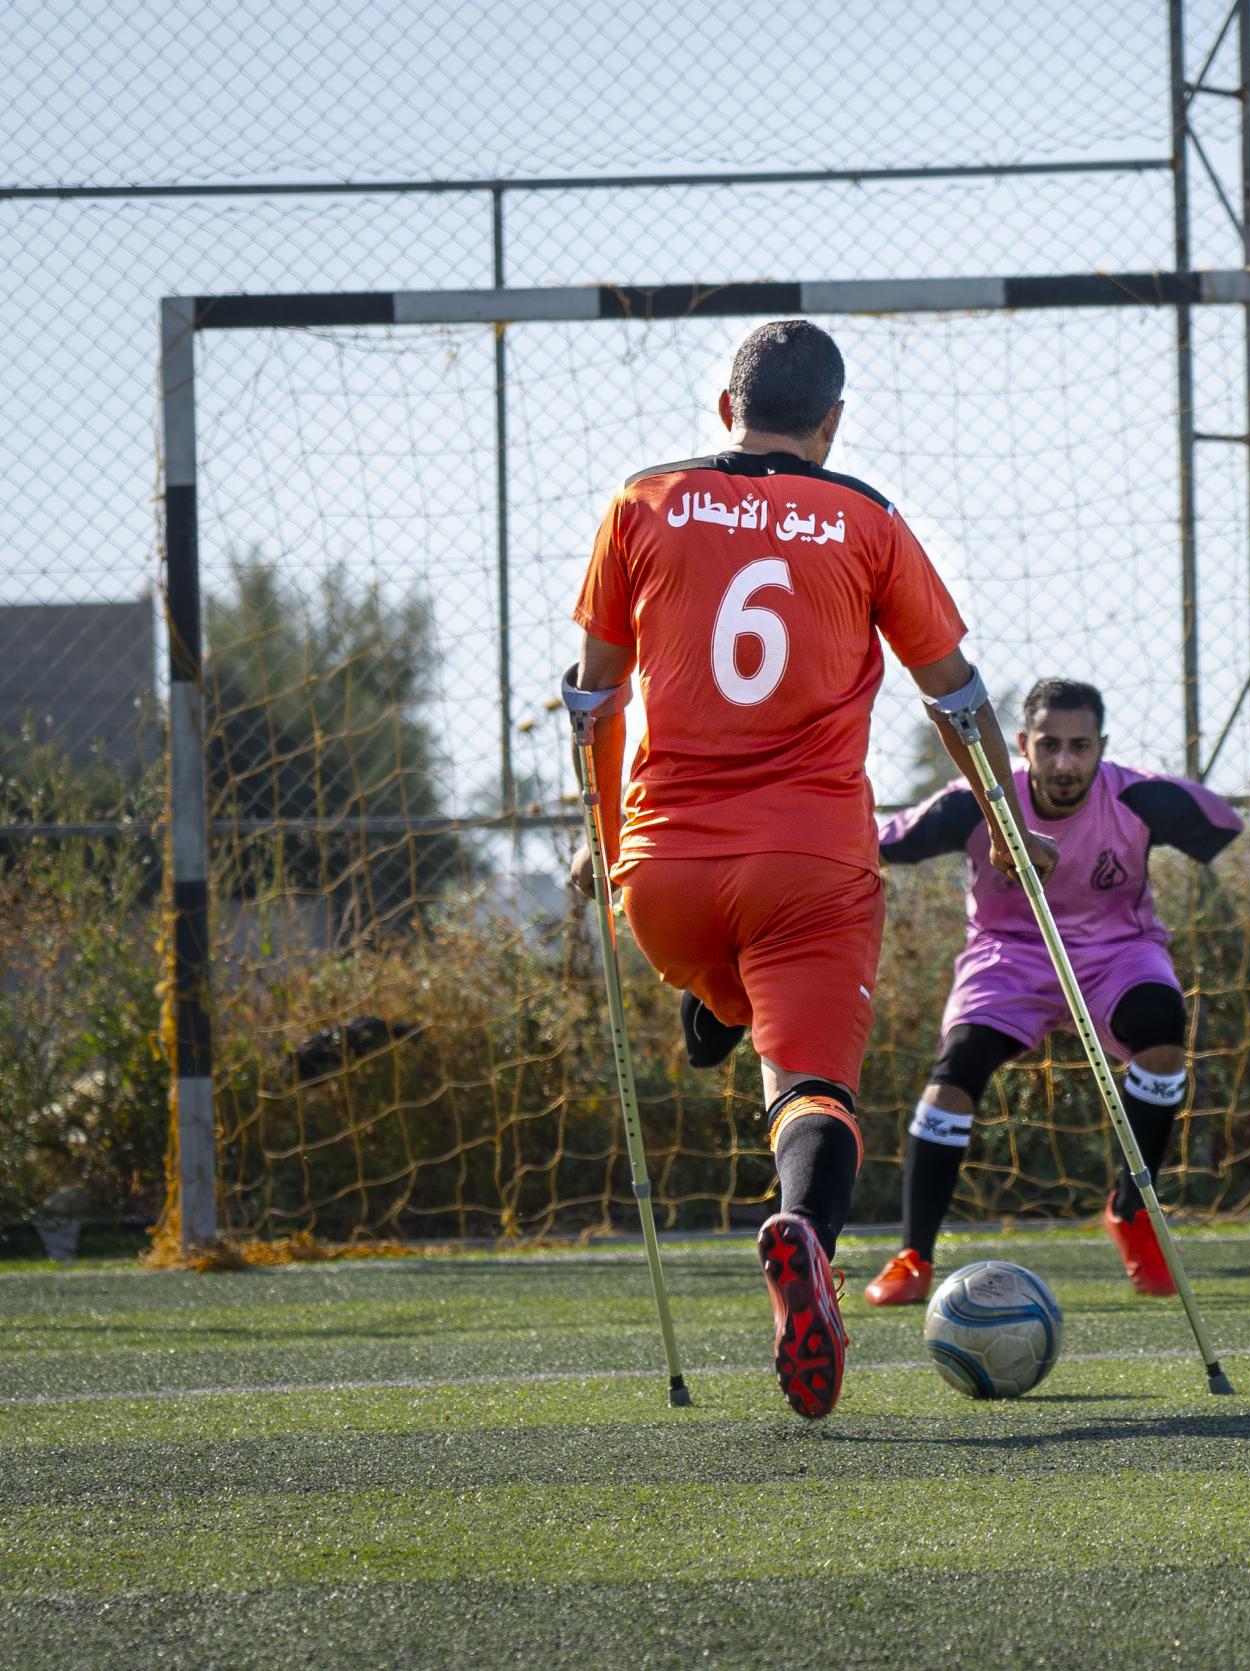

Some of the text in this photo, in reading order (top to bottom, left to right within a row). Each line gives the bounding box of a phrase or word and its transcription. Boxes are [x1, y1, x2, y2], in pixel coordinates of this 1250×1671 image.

[667, 491, 846, 545] فريق الأبطال
[710, 556, 795, 706] 6
